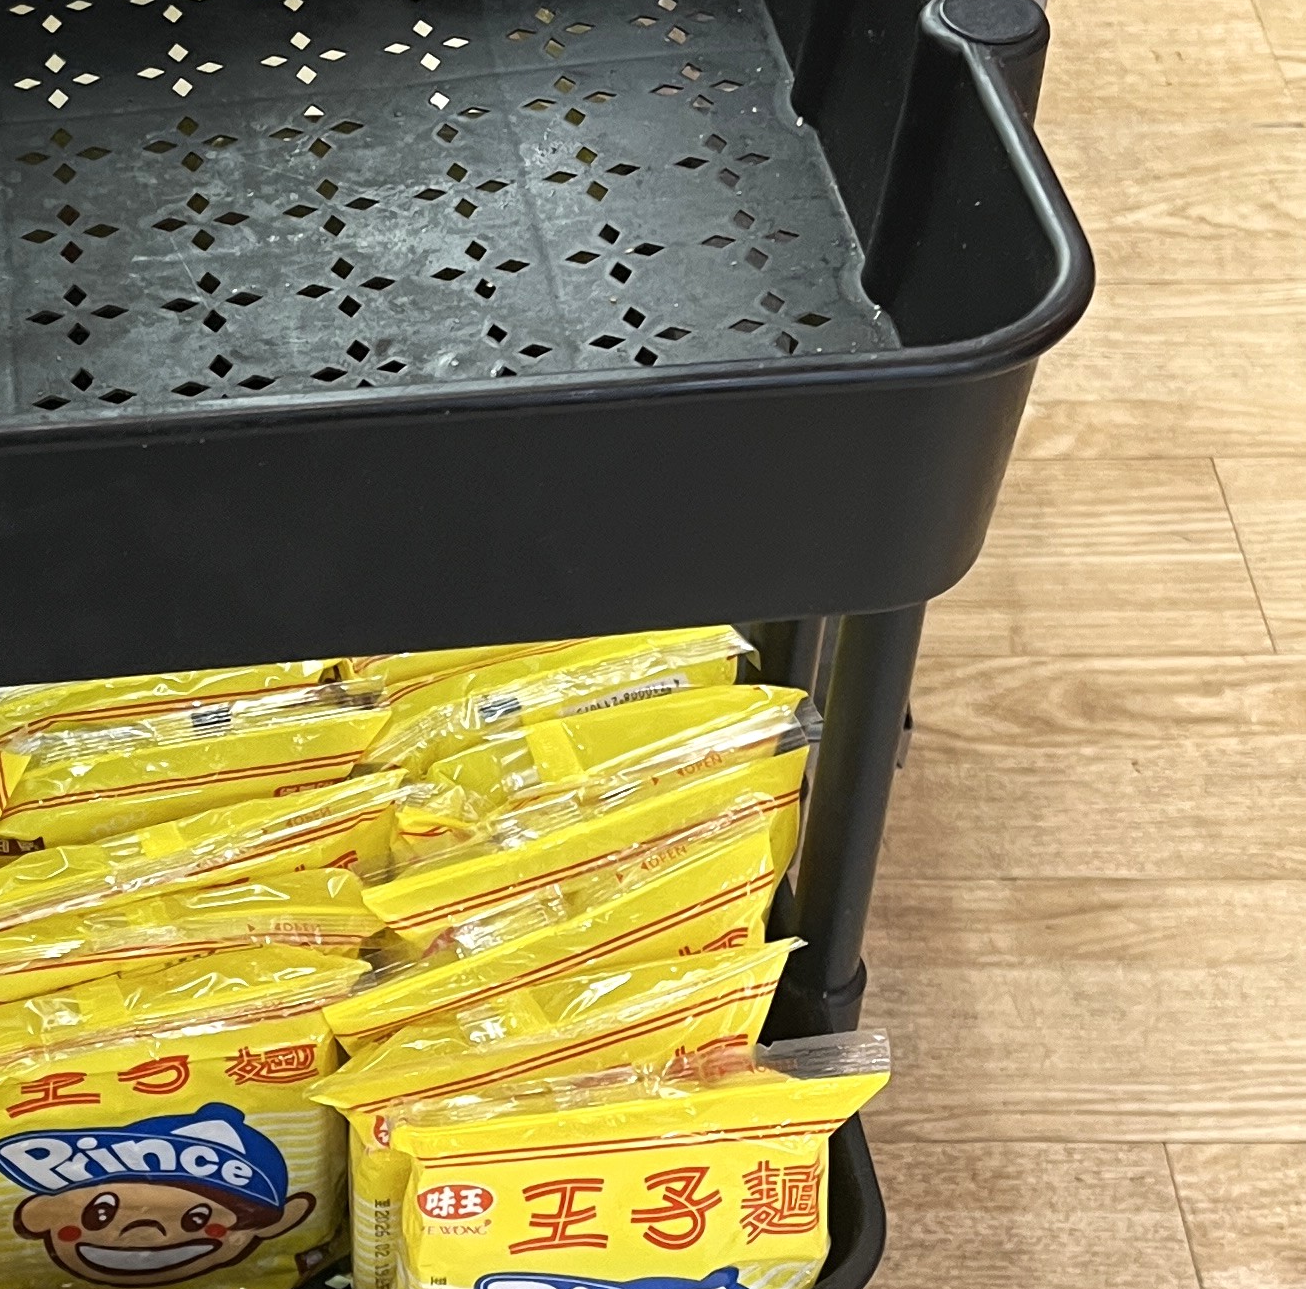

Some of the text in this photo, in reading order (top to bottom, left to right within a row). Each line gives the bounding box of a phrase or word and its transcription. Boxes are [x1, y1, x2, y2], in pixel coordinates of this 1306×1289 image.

[685, 752, 723, 775] OPEN
[648, 845, 687, 870] OPEN
[0, 1135, 254, 1192] Prince
[425, 1186, 484, 1217] 味王
[509, 1159, 821, 1255] 王子麵
